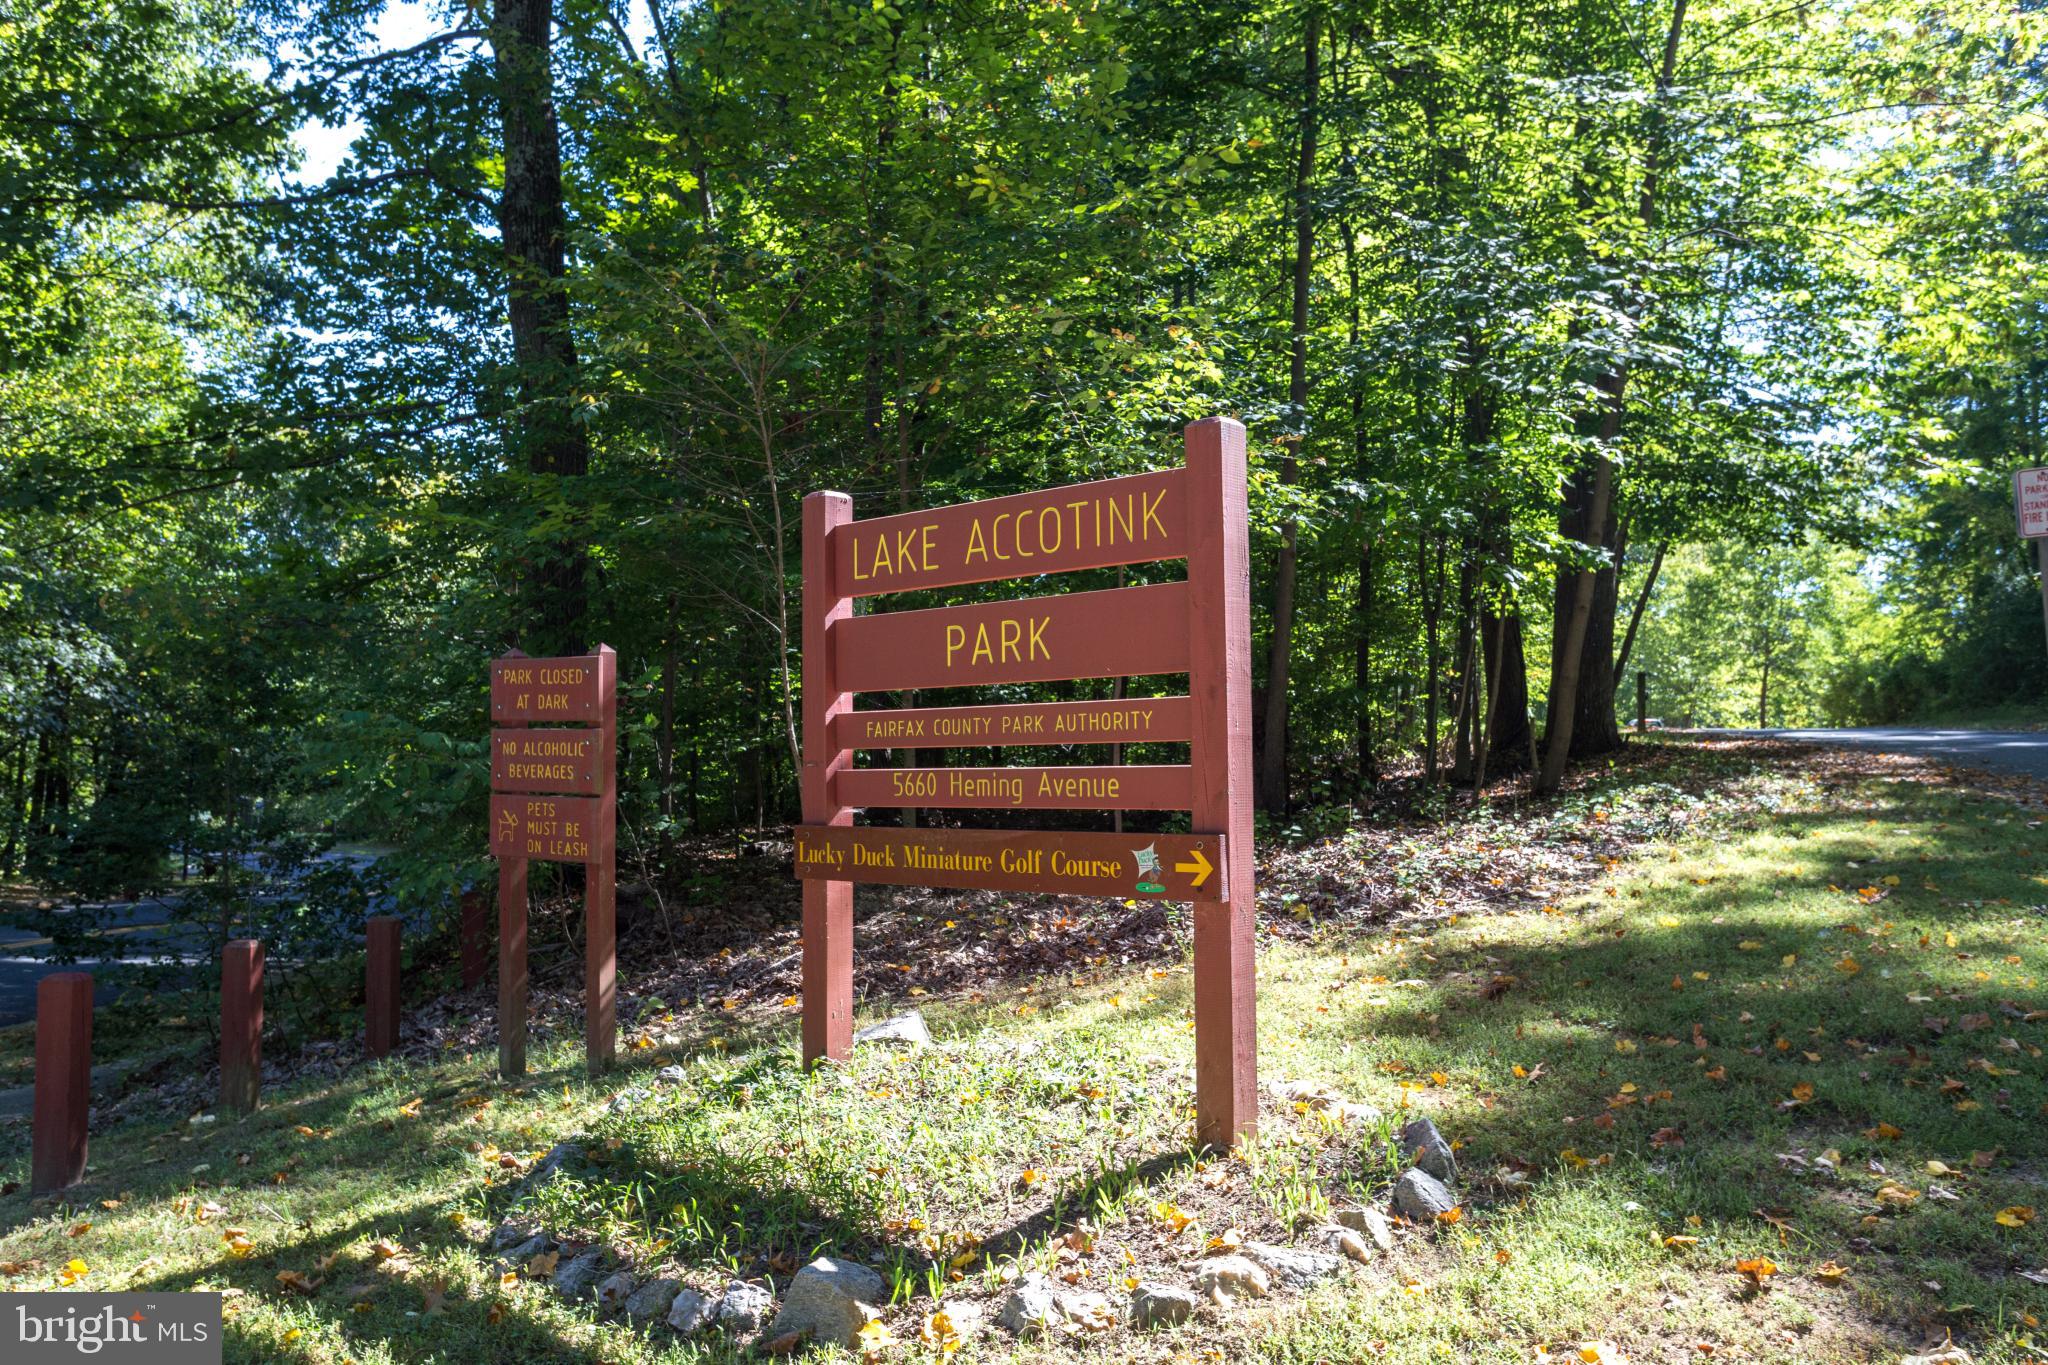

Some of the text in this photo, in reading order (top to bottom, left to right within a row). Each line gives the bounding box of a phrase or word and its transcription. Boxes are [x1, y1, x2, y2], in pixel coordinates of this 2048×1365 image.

[853, 489, 1167, 581] LAKE ACCOTINK
[946, 616, 1051, 667] PARK
[503, 669, 583, 685] PARK CLOSED
[517, 695, 568, 709] AT DARK
[866, 710, 1153, 738] FAIRFAX COUNTY PARK AUTHORITY
[503, 742, 584, 757] NO ALCOHOLIC
[509, 764, 574, 780] BEVERAGES
[893, 772, 1120, 804] 5660 Heming Avenue
[527, 803, 555, 817] PETS
[527, 821, 580, 837] MUST BE
[527, 840, 588, 856] ON LEASH
[799, 841, 1122, 879] Lucky Duck Miniature Golf Course
